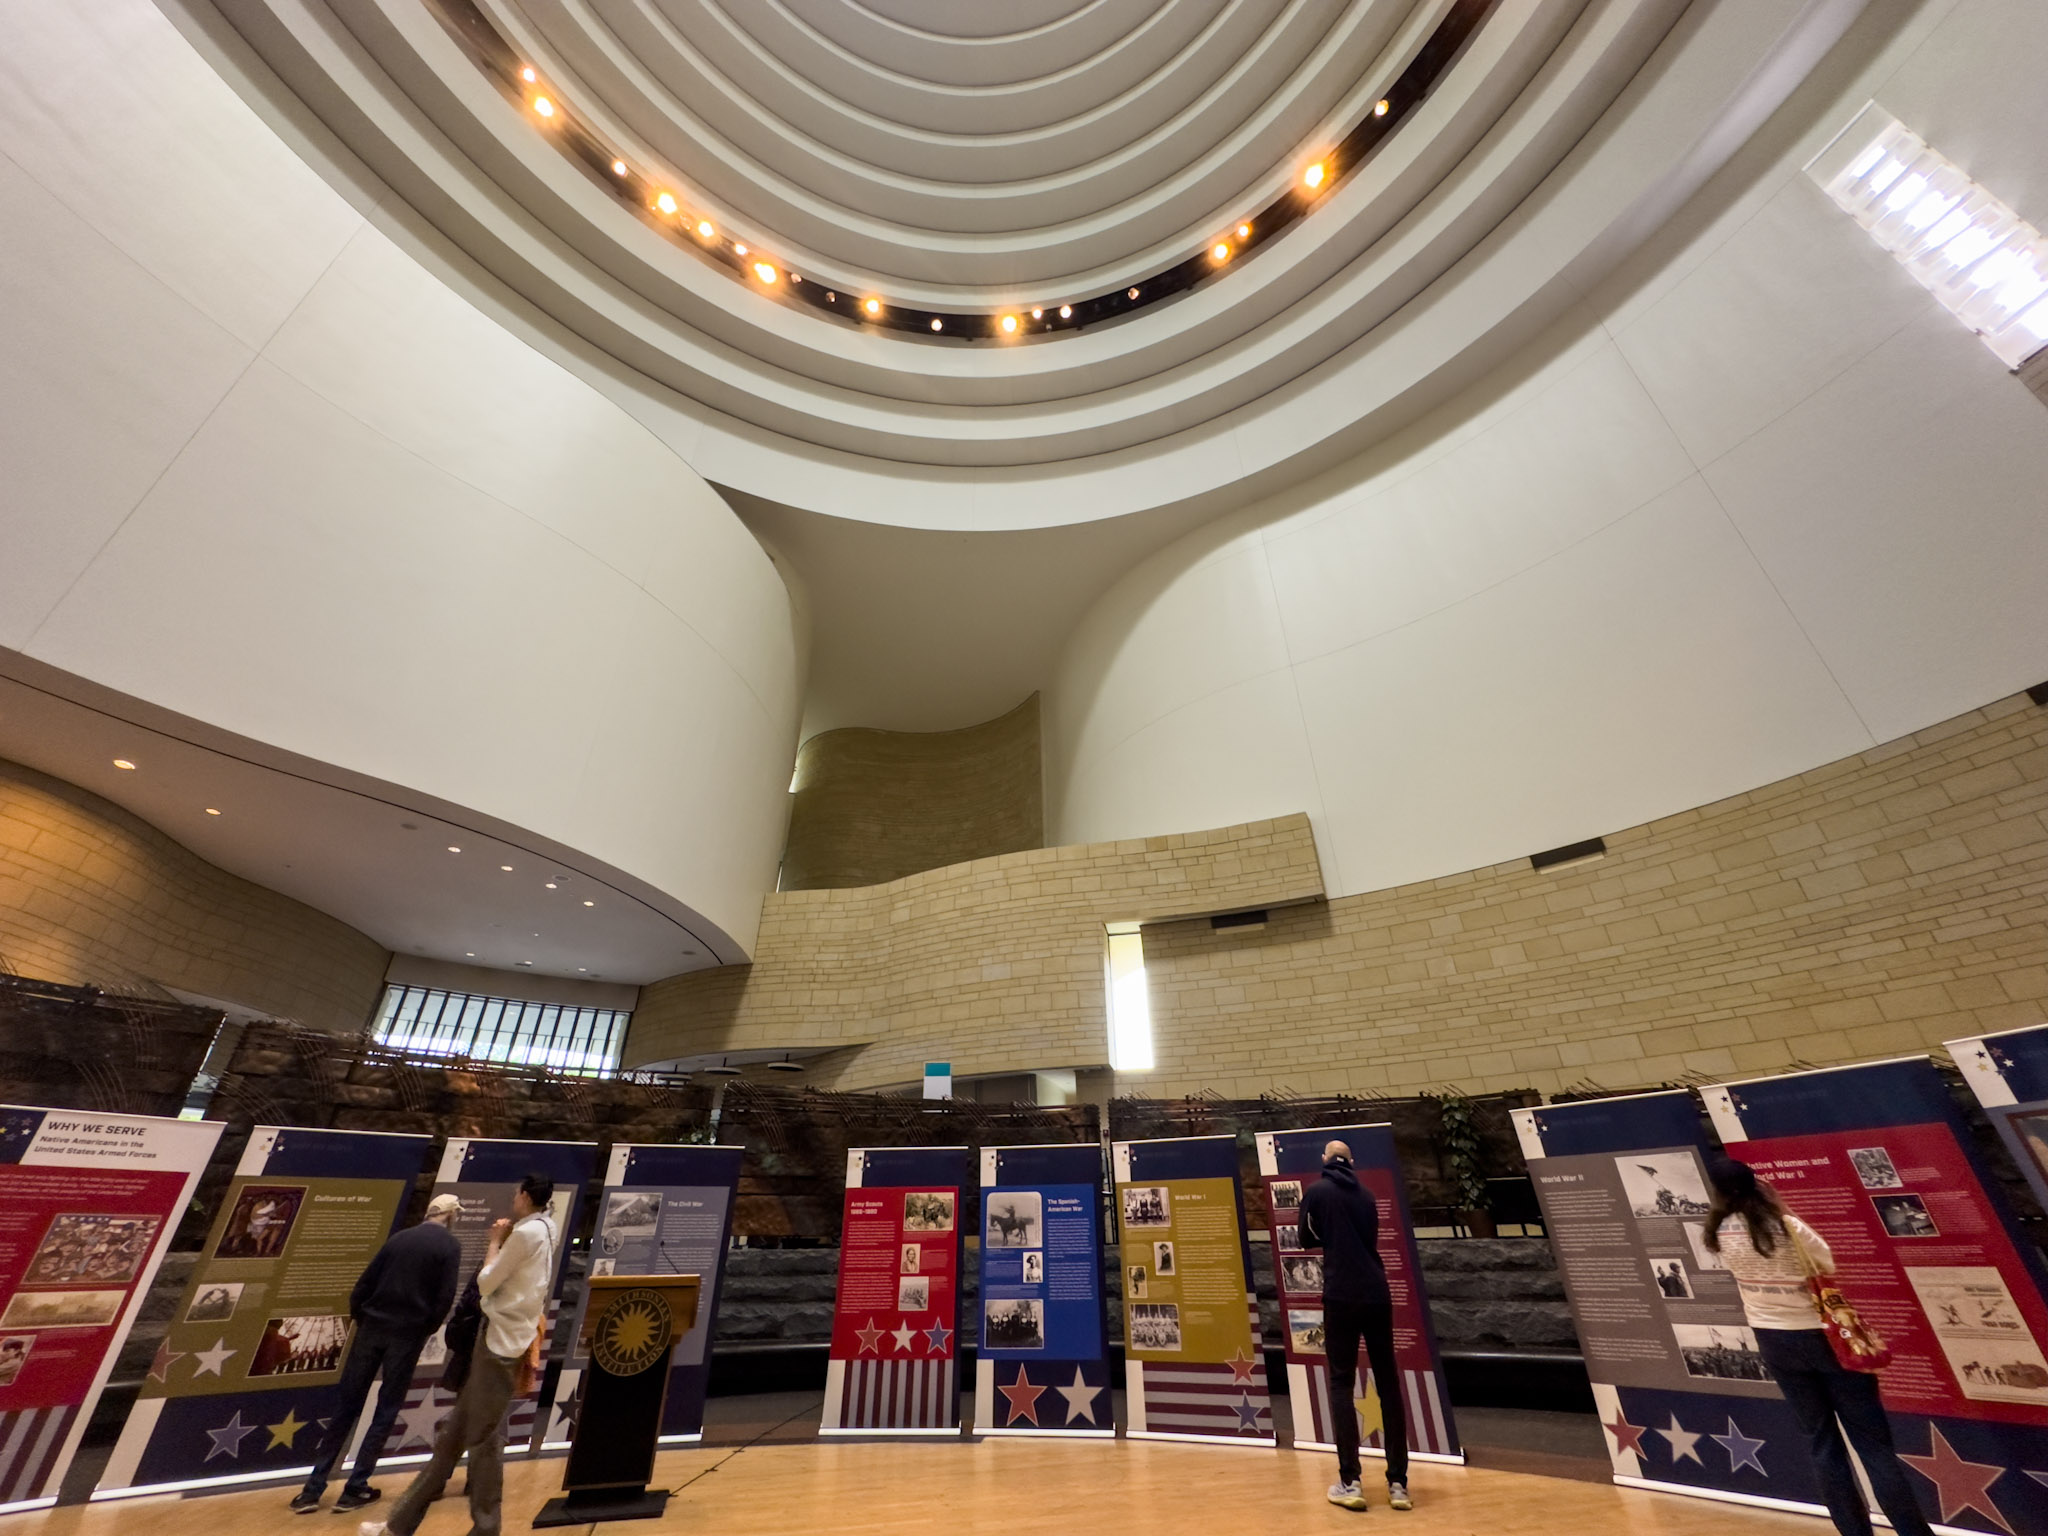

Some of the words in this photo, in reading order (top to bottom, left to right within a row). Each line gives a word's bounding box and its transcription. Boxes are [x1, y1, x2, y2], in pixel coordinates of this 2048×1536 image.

[48, 1121, 80, 1131] WHY
[83, 1123, 104, 1133] WE
[105, 1125, 147, 1136] SERVE
[40, 1136, 70, 1144] Native
[72, 1138, 118, 1146] Americans
[34, 1145, 64, 1153] United
[66, 1147, 95, 1155] States
[97, 1149, 127, 1157] Armed
[1773, 1160, 1810, 1168] Women
[1811, 1157, 1831, 1166] and
[1539, 1175, 1561, 1183] World
[1775, 1171, 1795, 1179] War
[1796, 1170, 1805, 1178] II
[314, 1194, 346, 1202] Cultures
[602, 1290, 671, 1322] SMITHSONIAN
[595, 1342, 664, 1375] INSTITUTION
